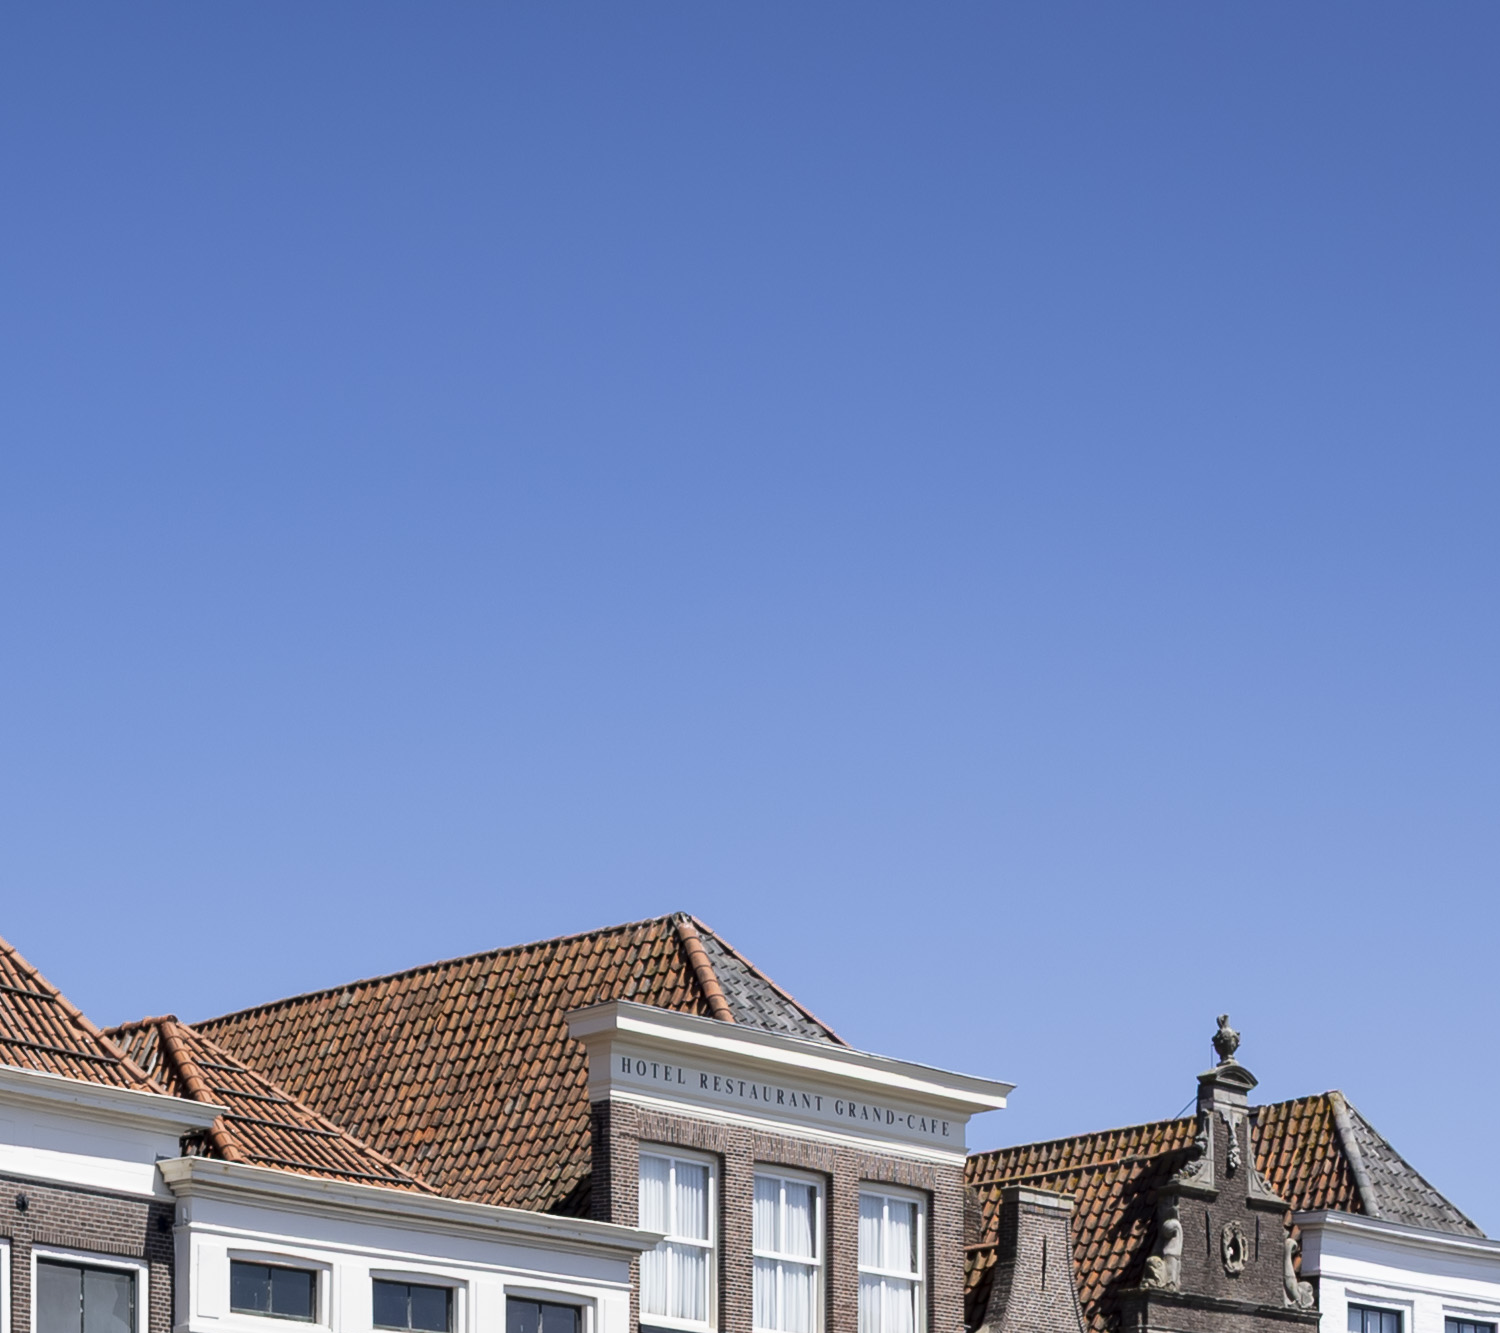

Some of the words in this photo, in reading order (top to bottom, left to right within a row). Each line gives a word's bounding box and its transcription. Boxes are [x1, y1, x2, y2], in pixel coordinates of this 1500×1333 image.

[621, 1056, 687, 1085] HOTEL
[699, 1072, 824, 1112] RESTAURANT
[834, 1099, 951, 1138] GRAND-CAFE
